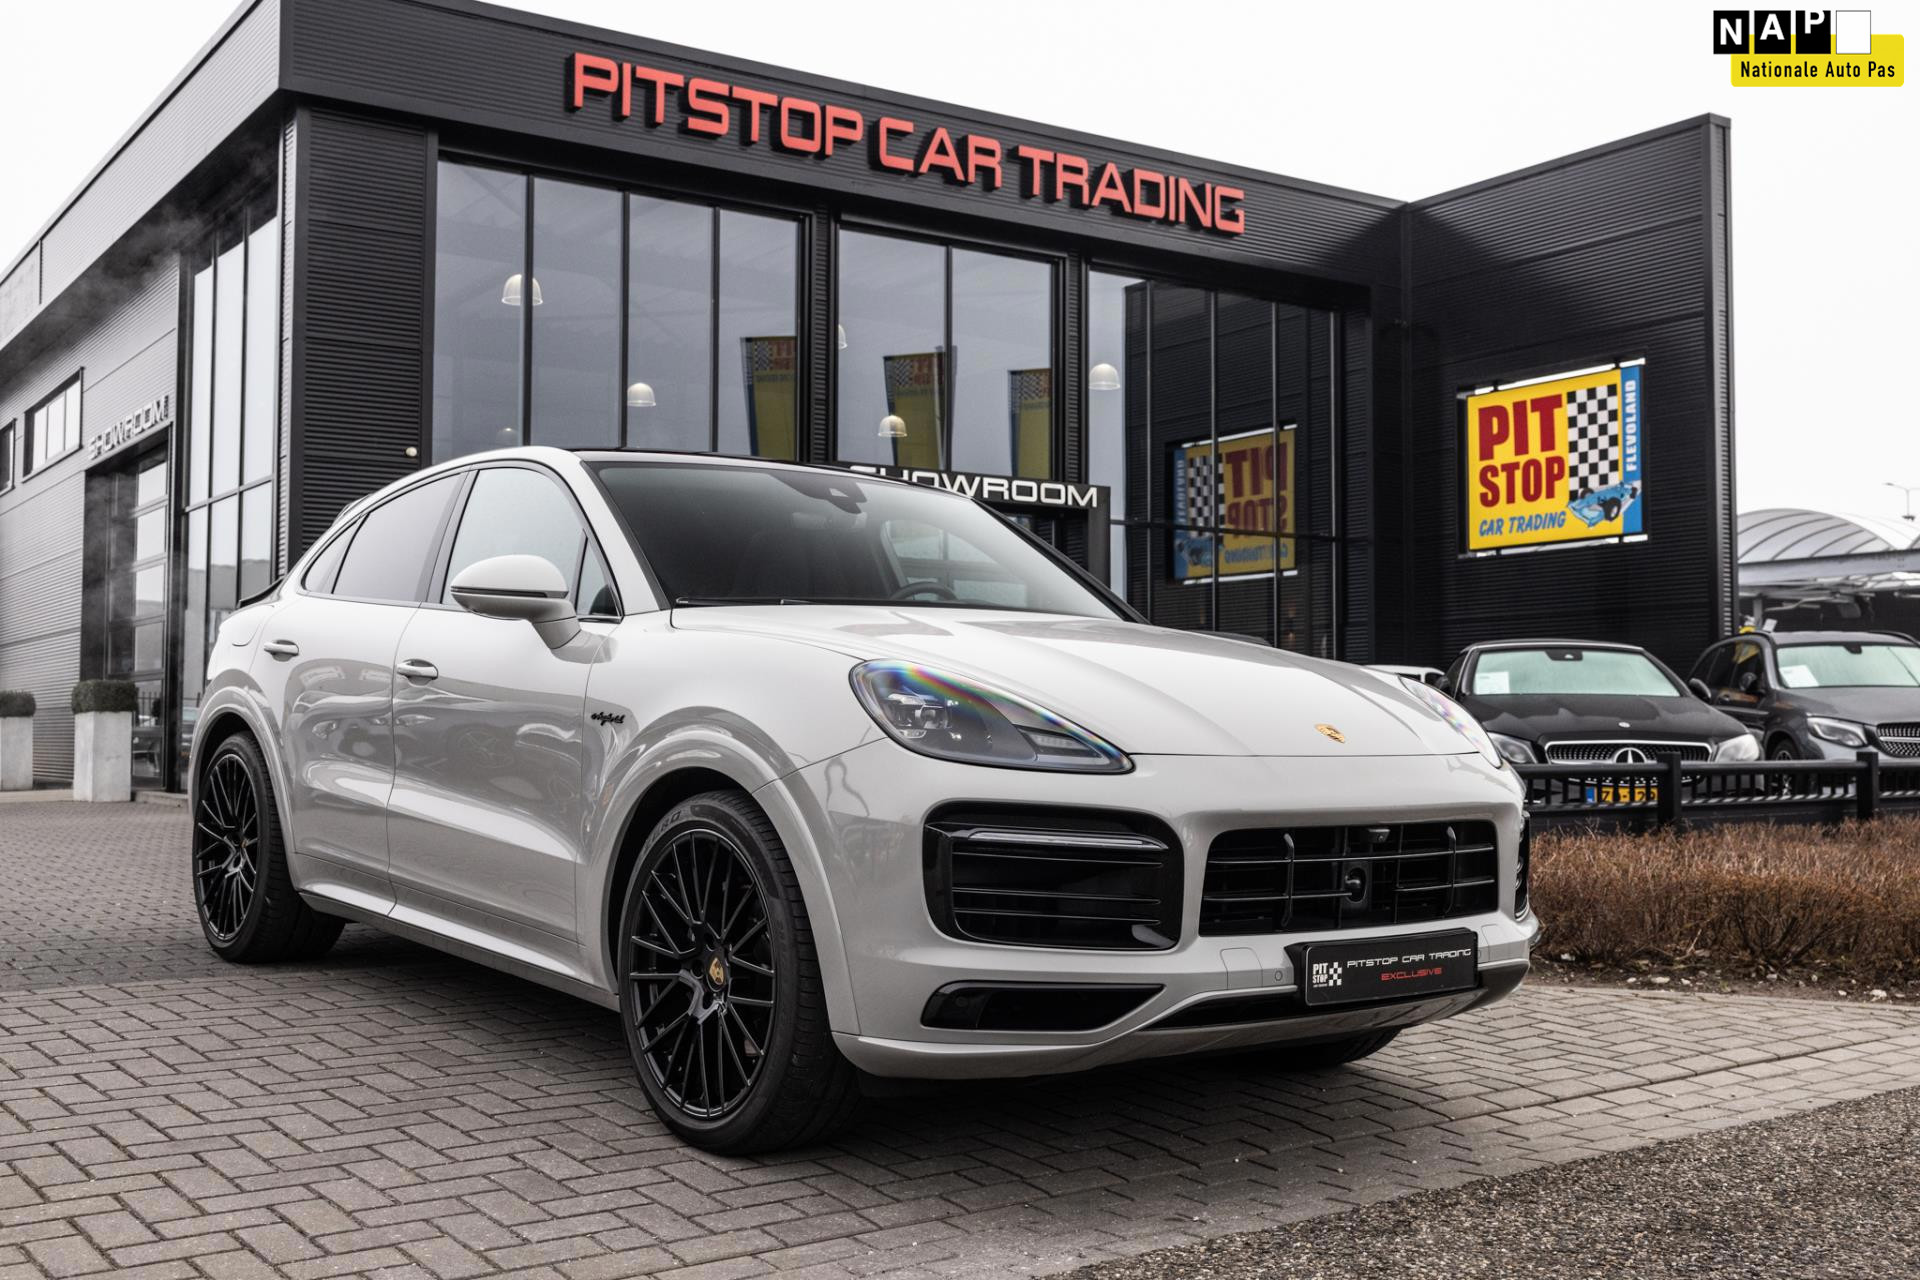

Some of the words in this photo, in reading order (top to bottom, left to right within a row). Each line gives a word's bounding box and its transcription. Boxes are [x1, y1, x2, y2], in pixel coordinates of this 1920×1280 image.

[573, 52, 864, 157] PITSTOP
[879, 116, 1003, 188] CAR
[1018, 144, 1246, 235] TRADING
[1478, 394, 1563, 461] PIT
[1624, 379, 1638, 472] FLEVOLAND
[850, 465, 1098, 508] OWROOM
[1479, 455, 1566, 508] STOP
[1478, 517, 1505, 537] CAR
[1509, 510, 1567, 534] TRADING
[1312, 962, 1329, 975] PIT
[1347, 956, 1399, 969] PITSTOP
[1402, 953, 1425, 964] CAR
[1429, 948, 1472, 959] TRADING
[1380, 967, 1443, 982] EXCLUSIVE
[1312, 974, 1329, 984] STOP
